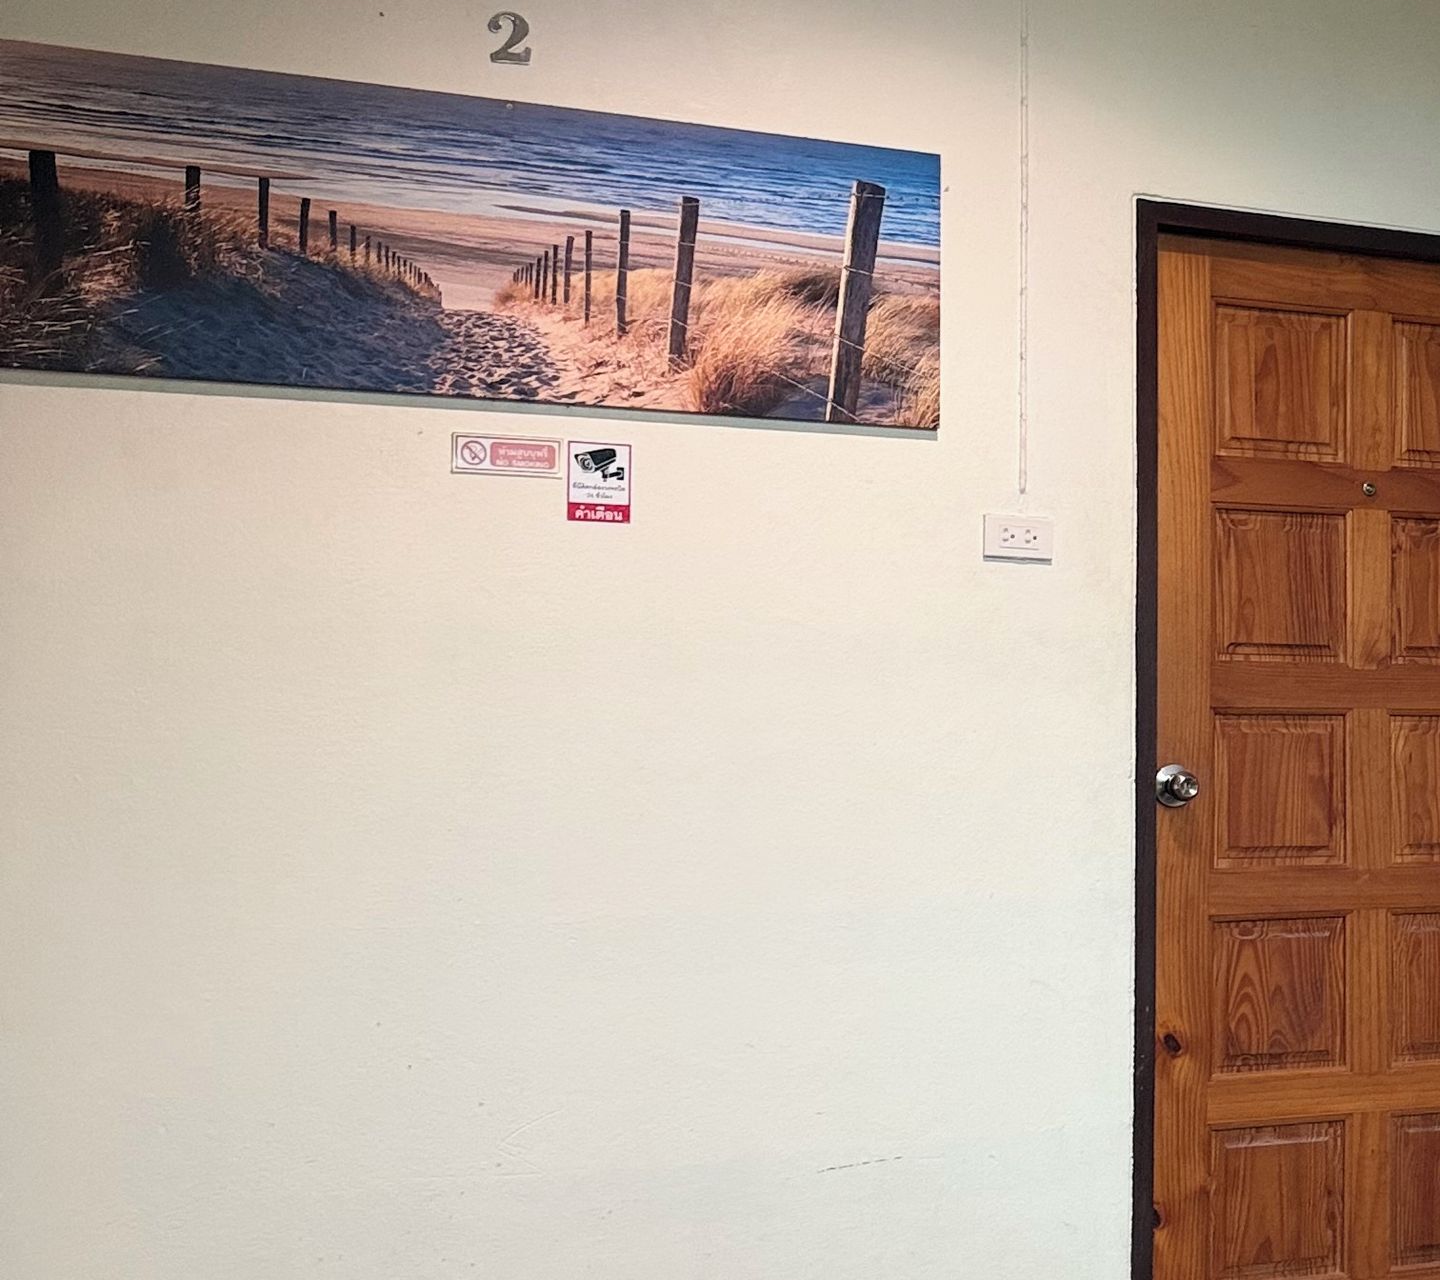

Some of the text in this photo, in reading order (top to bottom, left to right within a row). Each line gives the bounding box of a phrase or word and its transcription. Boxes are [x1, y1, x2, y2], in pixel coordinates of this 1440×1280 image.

[488, 11, 532, 65] 2
[575, 505, 623, 521] คำเตือน
